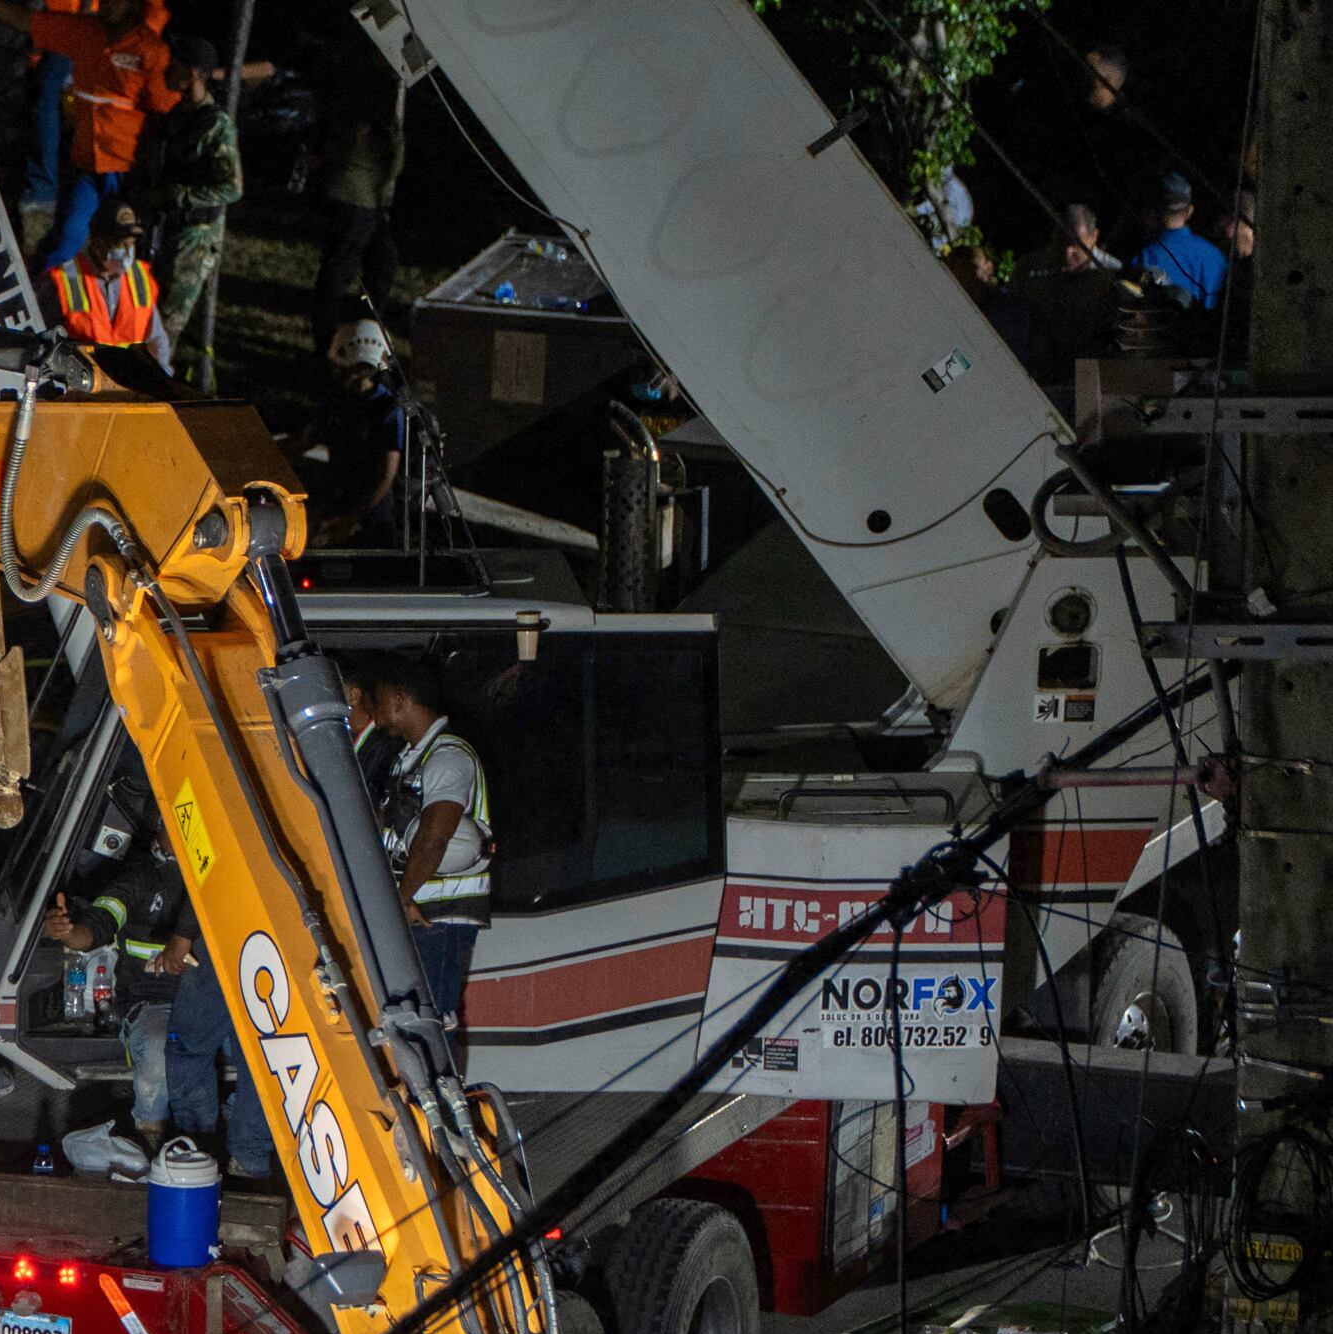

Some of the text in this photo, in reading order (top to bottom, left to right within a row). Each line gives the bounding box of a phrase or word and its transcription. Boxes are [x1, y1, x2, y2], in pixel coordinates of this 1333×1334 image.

[821, 976, 998, 1012] NORFOX
[861, 1025, 992, 1047] 809.732.529
[239, 929, 386, 1256] CASE
